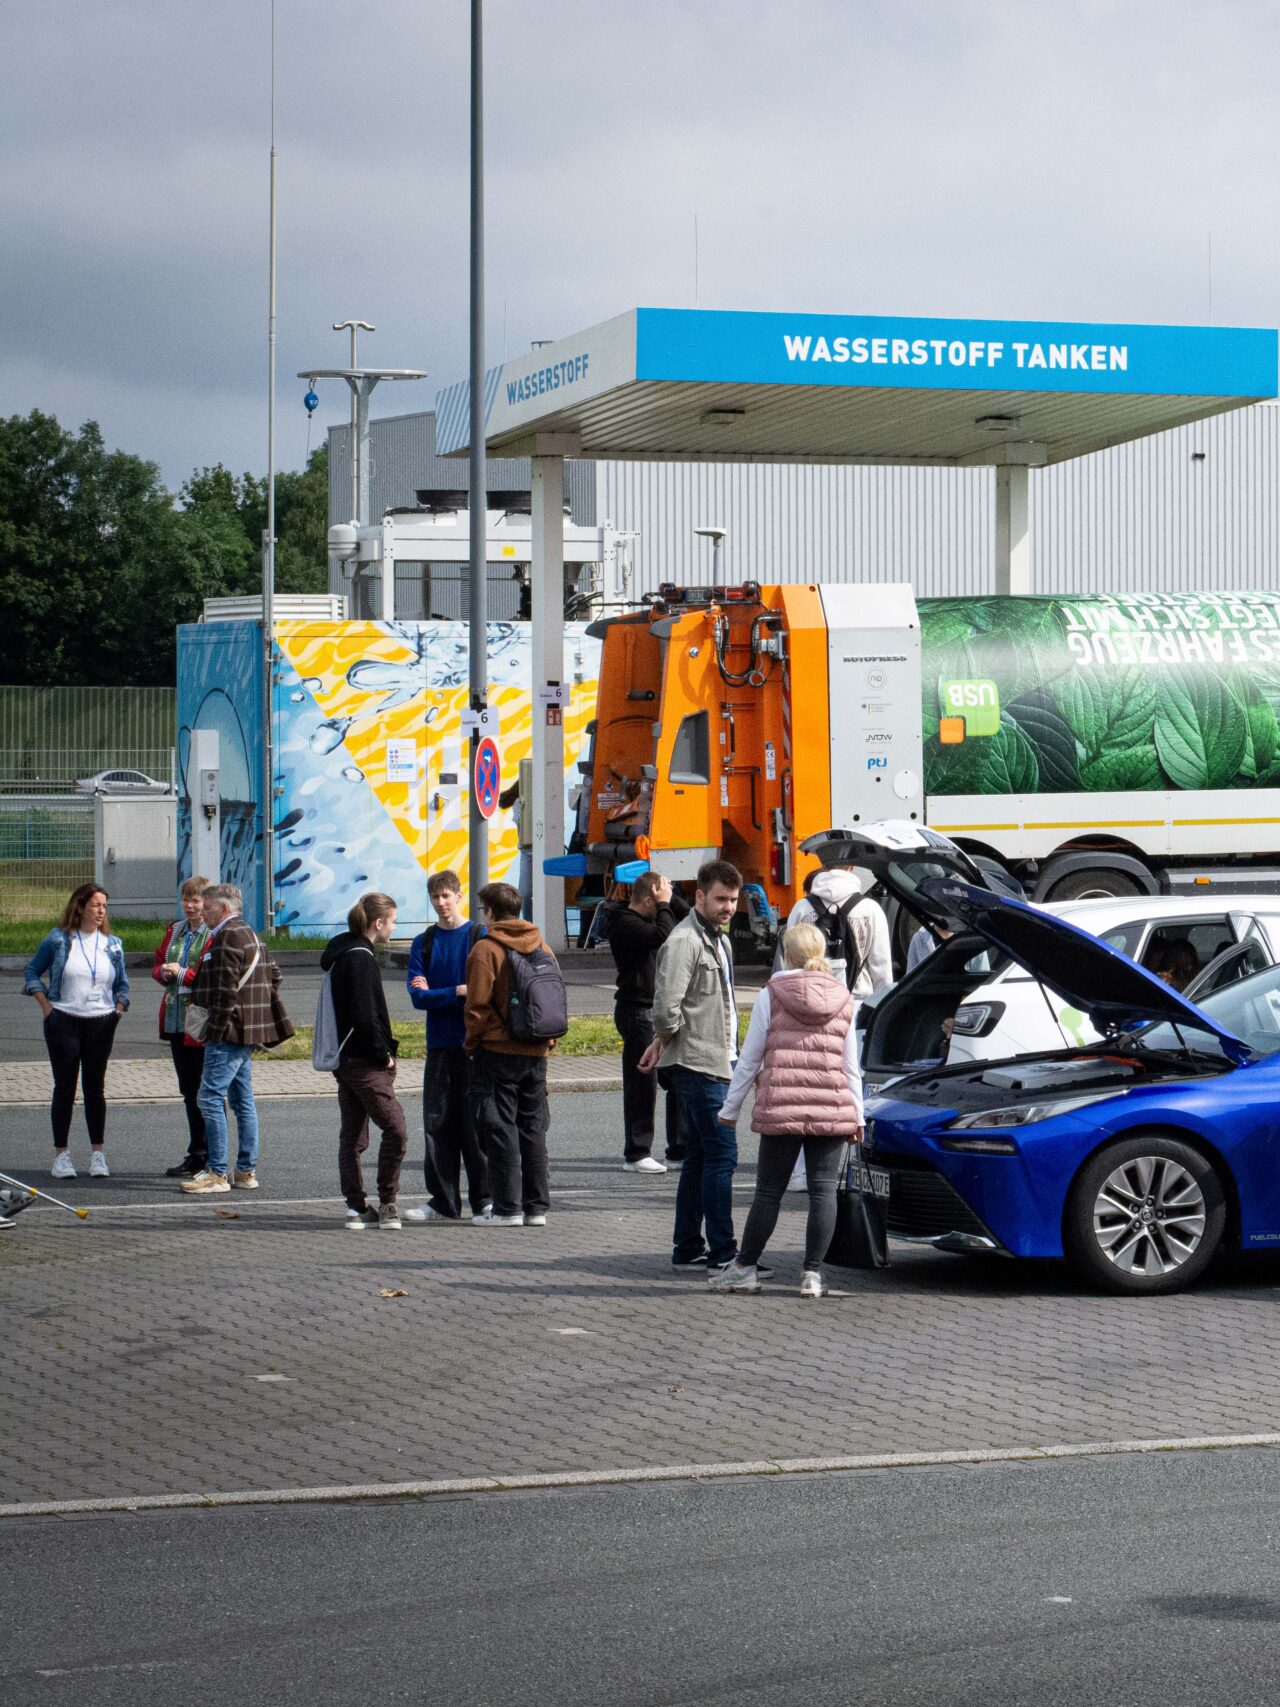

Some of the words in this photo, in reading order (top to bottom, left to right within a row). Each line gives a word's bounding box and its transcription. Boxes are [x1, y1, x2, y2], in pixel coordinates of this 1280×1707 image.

[783, 335, 1004, 367] WASSERSTOFF
[1012, 343, 1128, 370] TANKEN
[506, 353, 589, 406] WASSERSTOFF
[1061, 606, 1131, 631] MIT
[1128, 605, 1213, 631] SICH
[1066, 630, 1249, 665] FAHRZEUG
[555, 688, 562, 698] 6
[948, 683, 996, 706] USB
[481, 712, 489, 724] 6
